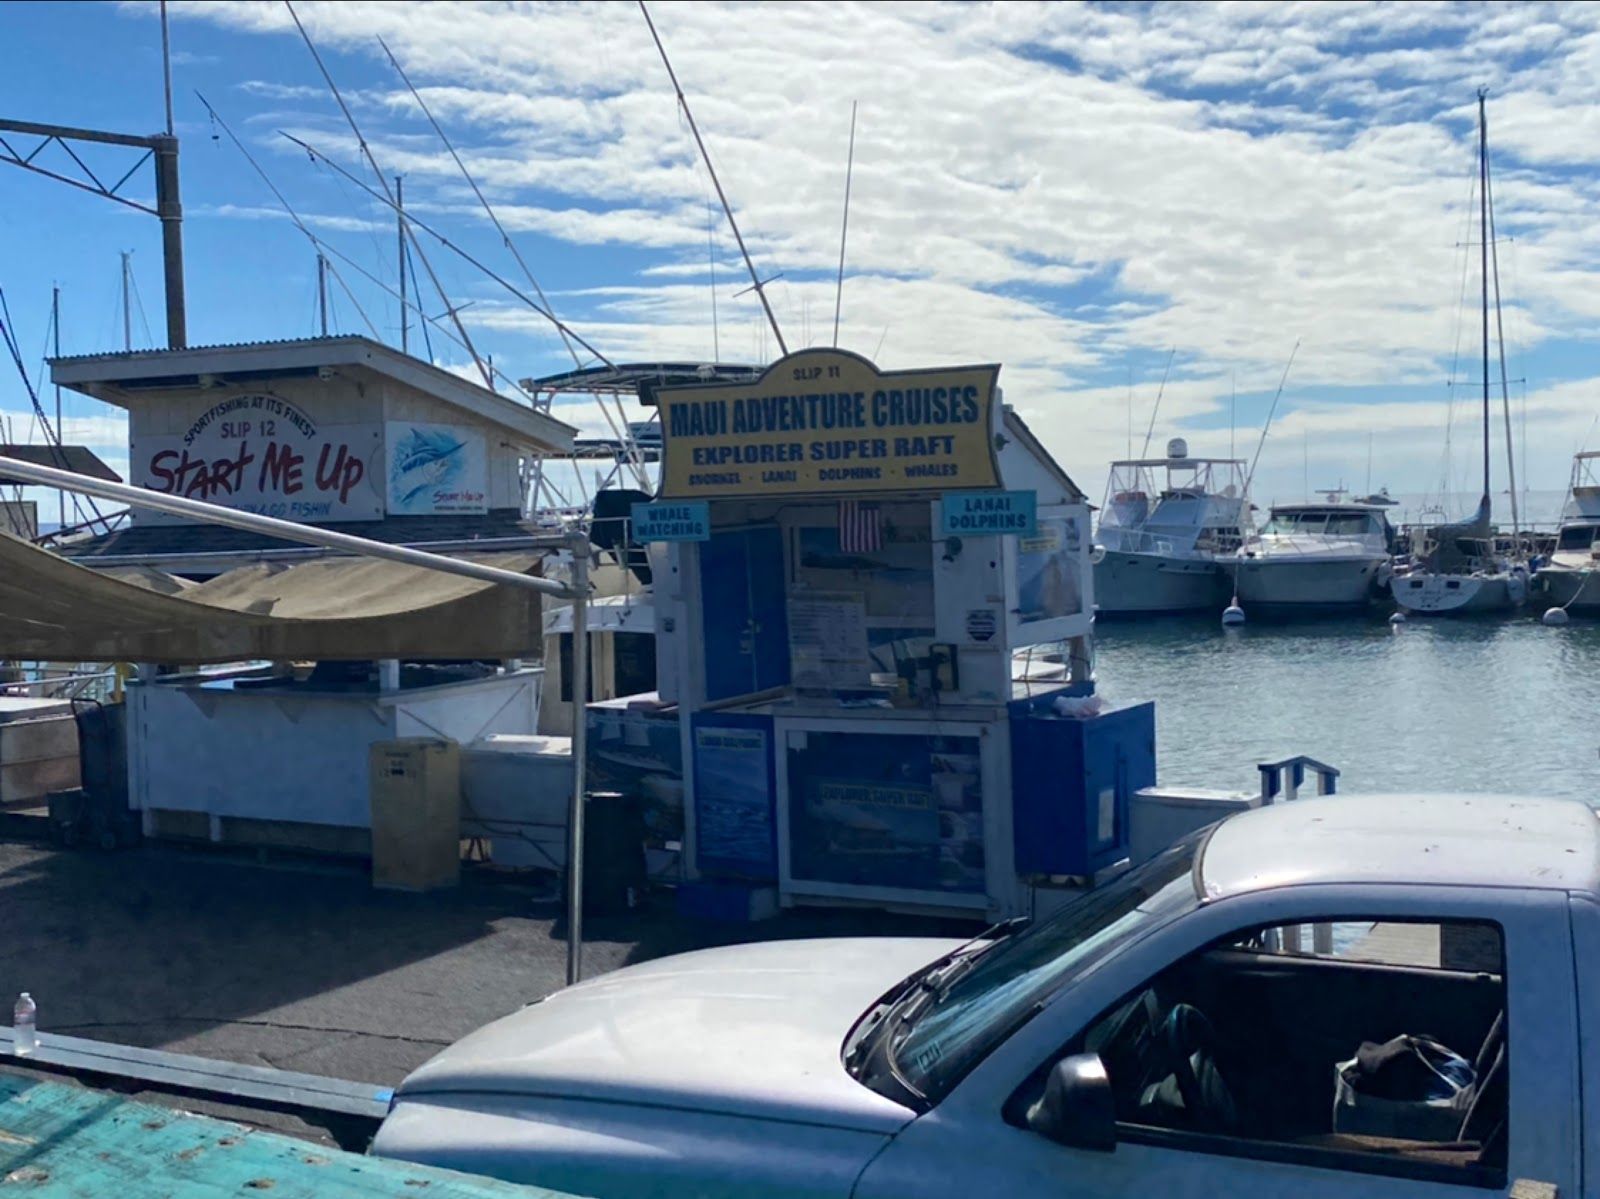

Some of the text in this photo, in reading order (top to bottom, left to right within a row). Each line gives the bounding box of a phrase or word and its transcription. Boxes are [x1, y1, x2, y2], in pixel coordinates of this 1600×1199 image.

[793, 365, 840, 381] SLIP 11
[671, 385, 979, 438] MAUI ADVENTURE CRUISES
[184, 396, 317, 447] SPORTFISHING AT ITS FINEST
[221, 420, 276, 439] SLIP 12
[693, 435, 955, 466] EXPLORER SUPER RAFT
[761, 469, 798, 484] LANAI
[818, 466, 882, 482] DOLPHINS
[904, 463, 959, 479] WHALES
[648, 507, 691, 521] WHALE
[964, 497, 1011, 513] LANAI
[637, 521, 703, 537] WATCHING
[949, 512, 1027, 530] DOLPHINS
